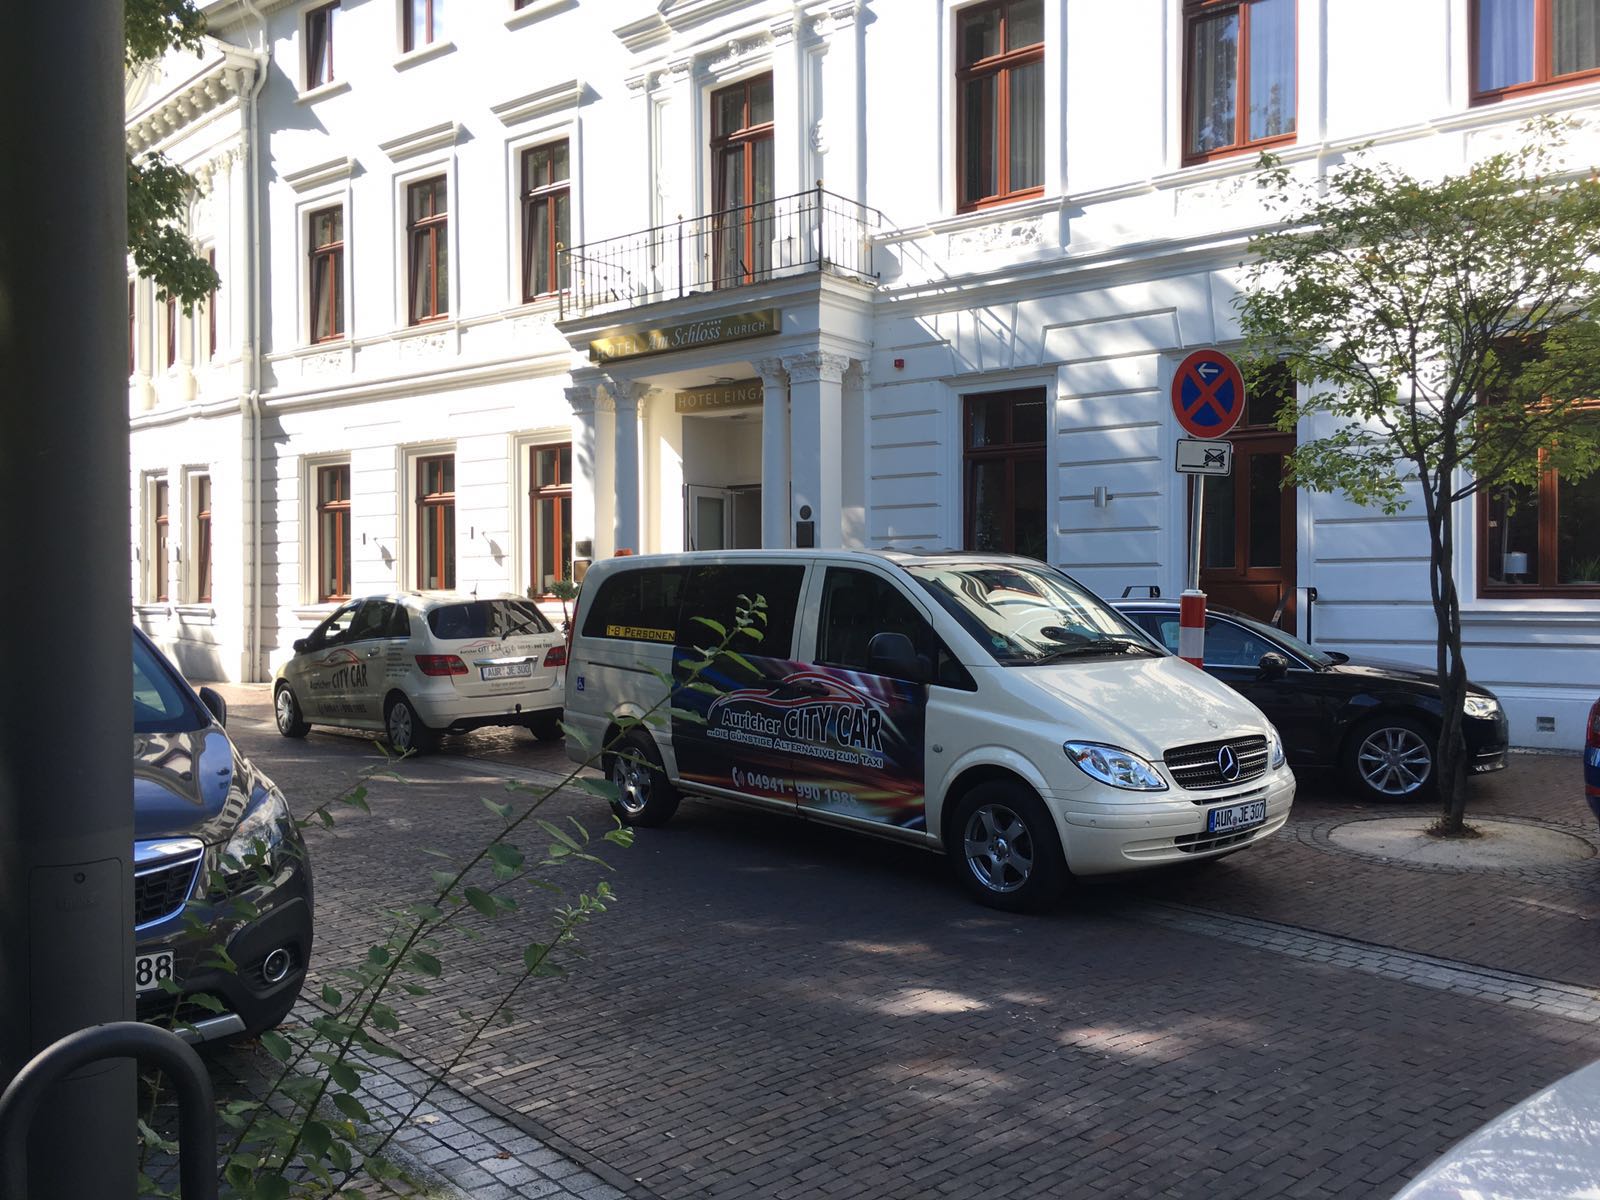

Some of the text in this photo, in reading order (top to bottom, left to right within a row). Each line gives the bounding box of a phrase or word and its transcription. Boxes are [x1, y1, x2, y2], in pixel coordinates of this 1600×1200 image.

[649, 336, 670, 350] Am
[672, 324, 721, 347] Schloss
[726, 322, 766, 337] AURICH
[679, 392, 720, 409] HOTEL
[624, 627, 675, 640] PERSONEN
[331, 665, 349, 689] CITY
[350, 663, 368, 688] CAR
[722, 705, 883, 753] Auricher CITY CAR
[730, 730, 773, 748] GÜNSTIGE
[774, 738, 835, 760] ALTERNATIVE
[836, 751, 860, 765] ZUM
[861, 754, 884, 769] TAXI
[747, 771, 785, 794] 04941
[795, 783, 820, 801] 990
[1215, 810, 1232, 828] AUR
[1239, 806, 1249, 822] JE
